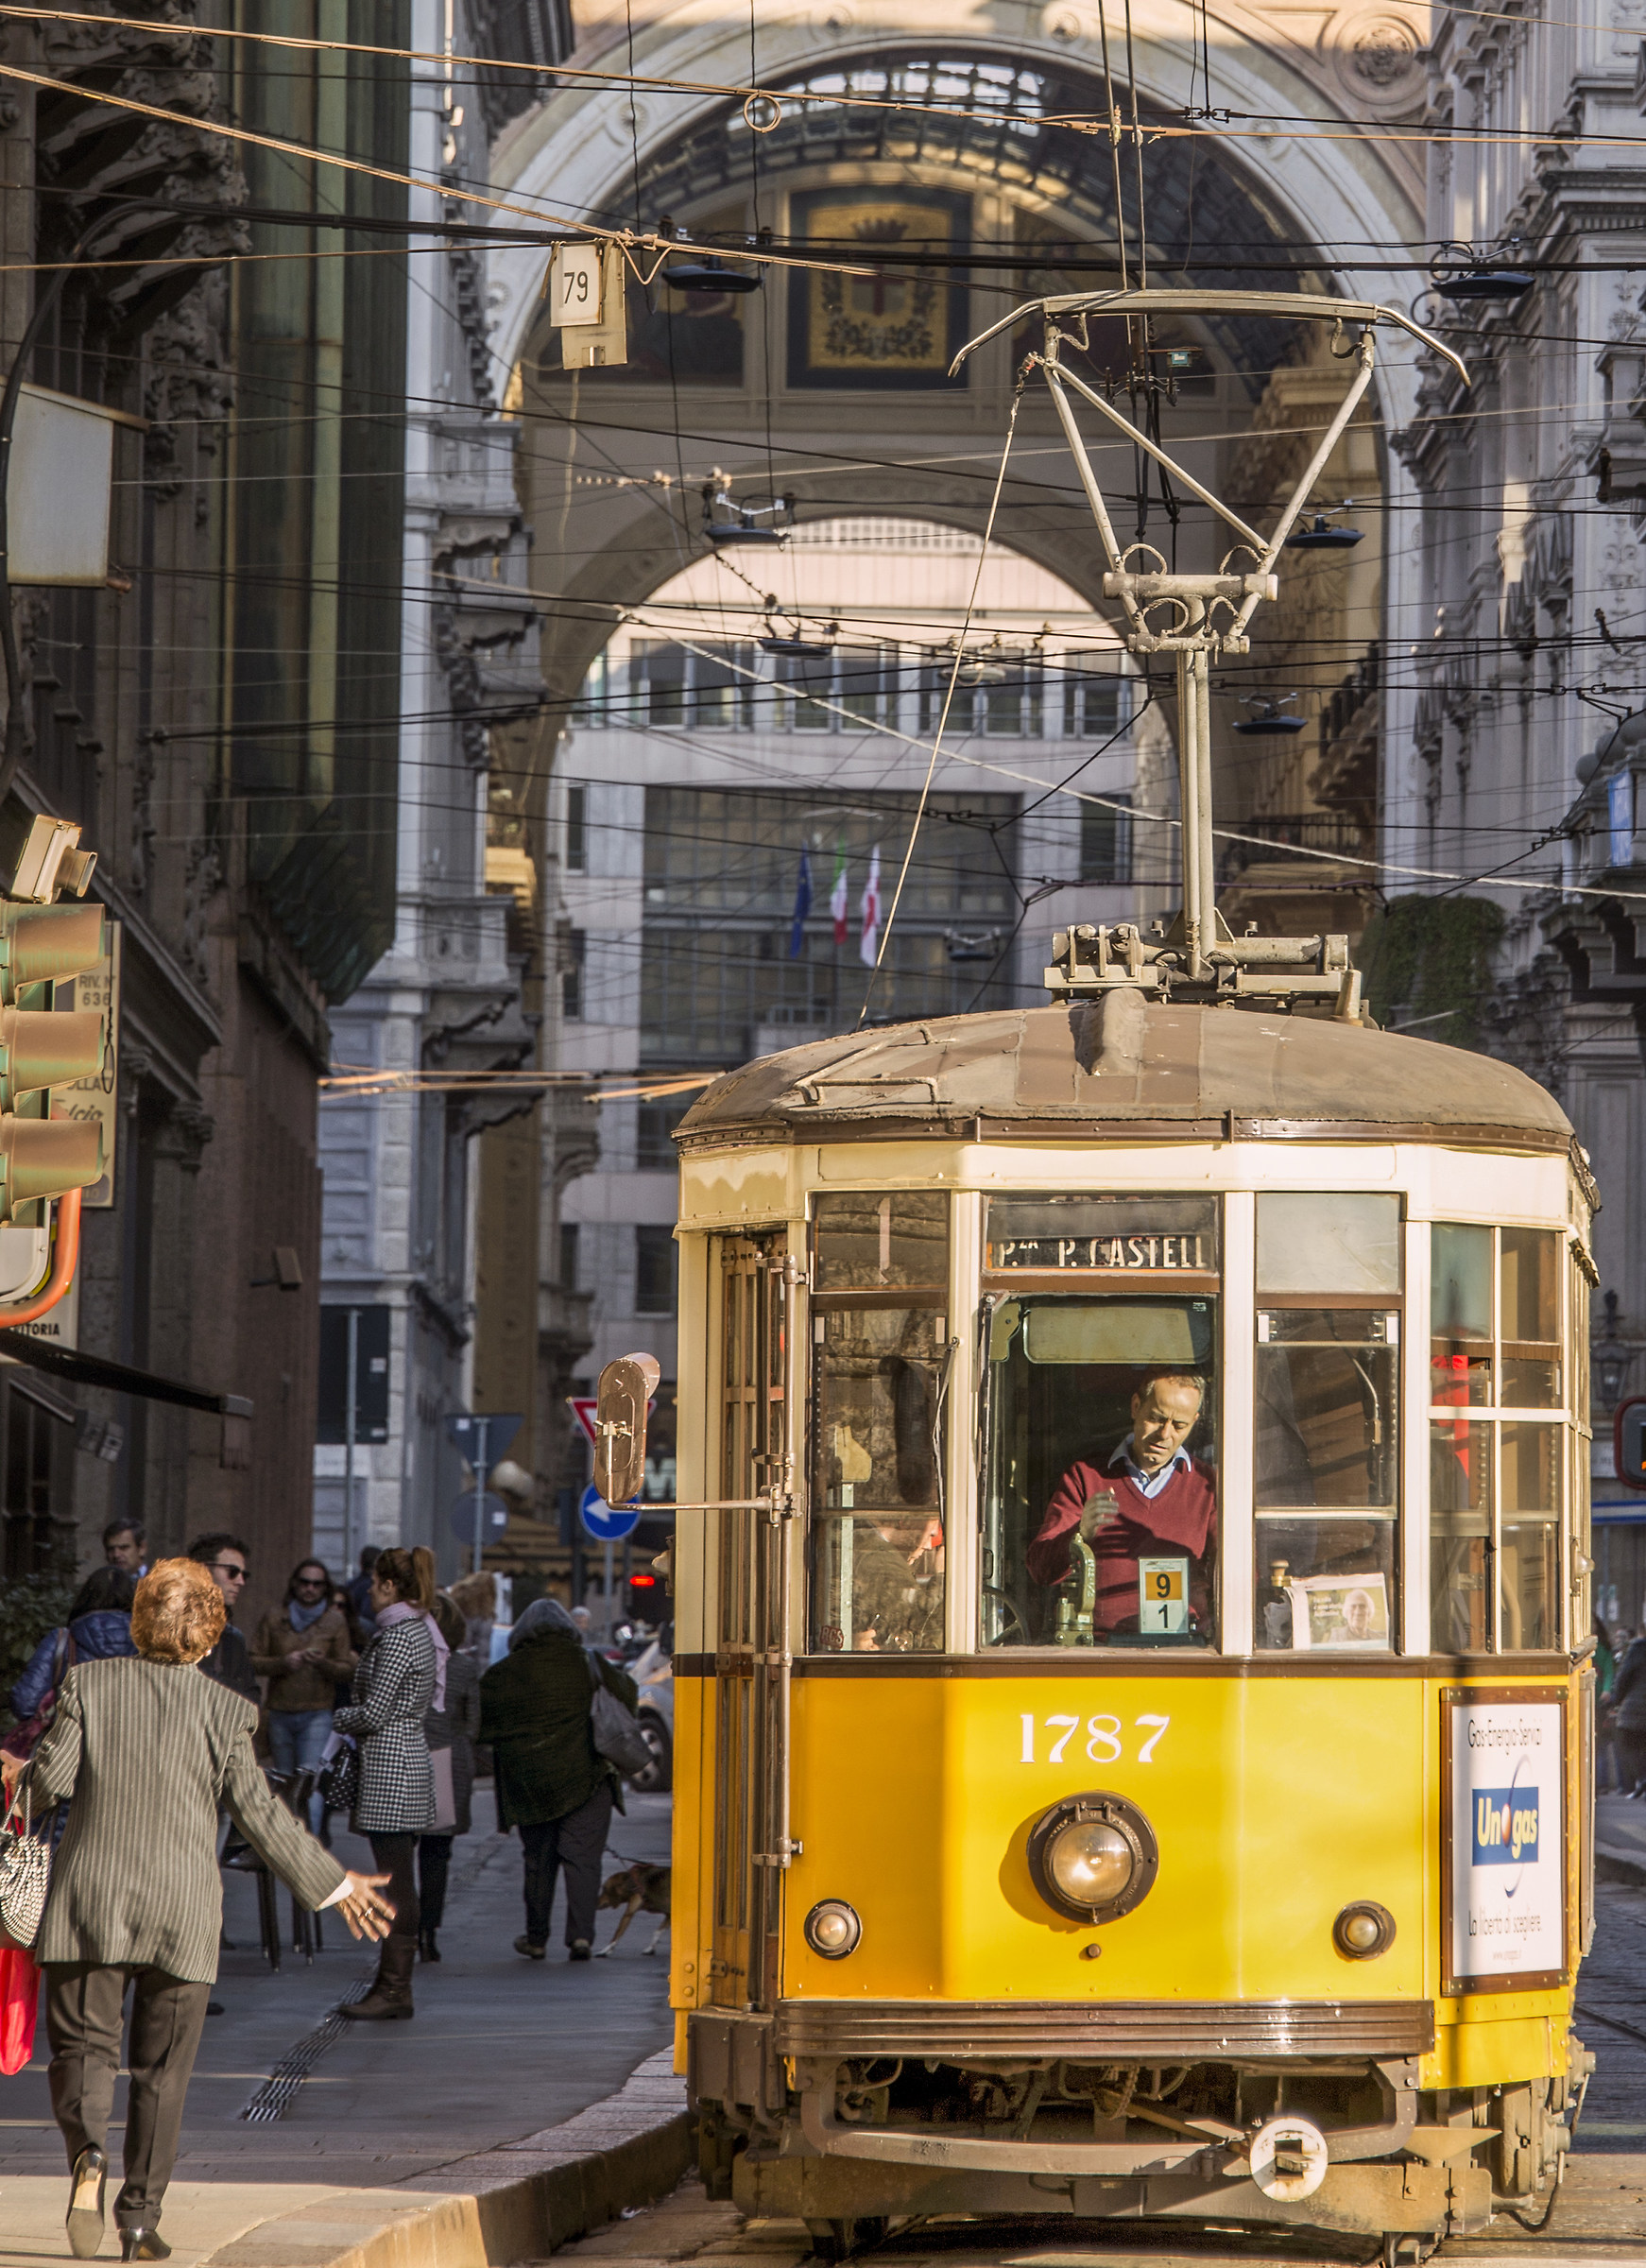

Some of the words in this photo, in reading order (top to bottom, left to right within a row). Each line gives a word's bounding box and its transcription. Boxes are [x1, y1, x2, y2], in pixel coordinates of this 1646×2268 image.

[564, 271, 589, 304] 79
[79, 974, 101, 989] RIV.
[82, 991, 111, 1006] 636
[1058, 1238, 1078, 1267] P.
[1089, 1236, 1208, 1267] CASTELL
[1156, 1573, 1171, 1599] 9
[1157, 1604, 1169, 1629] 1
[1020, 1714, 1170, 1763] 1787
[1468, 1910, 1478, 1936] La
[1505, 1904, 1512, 1933] di
